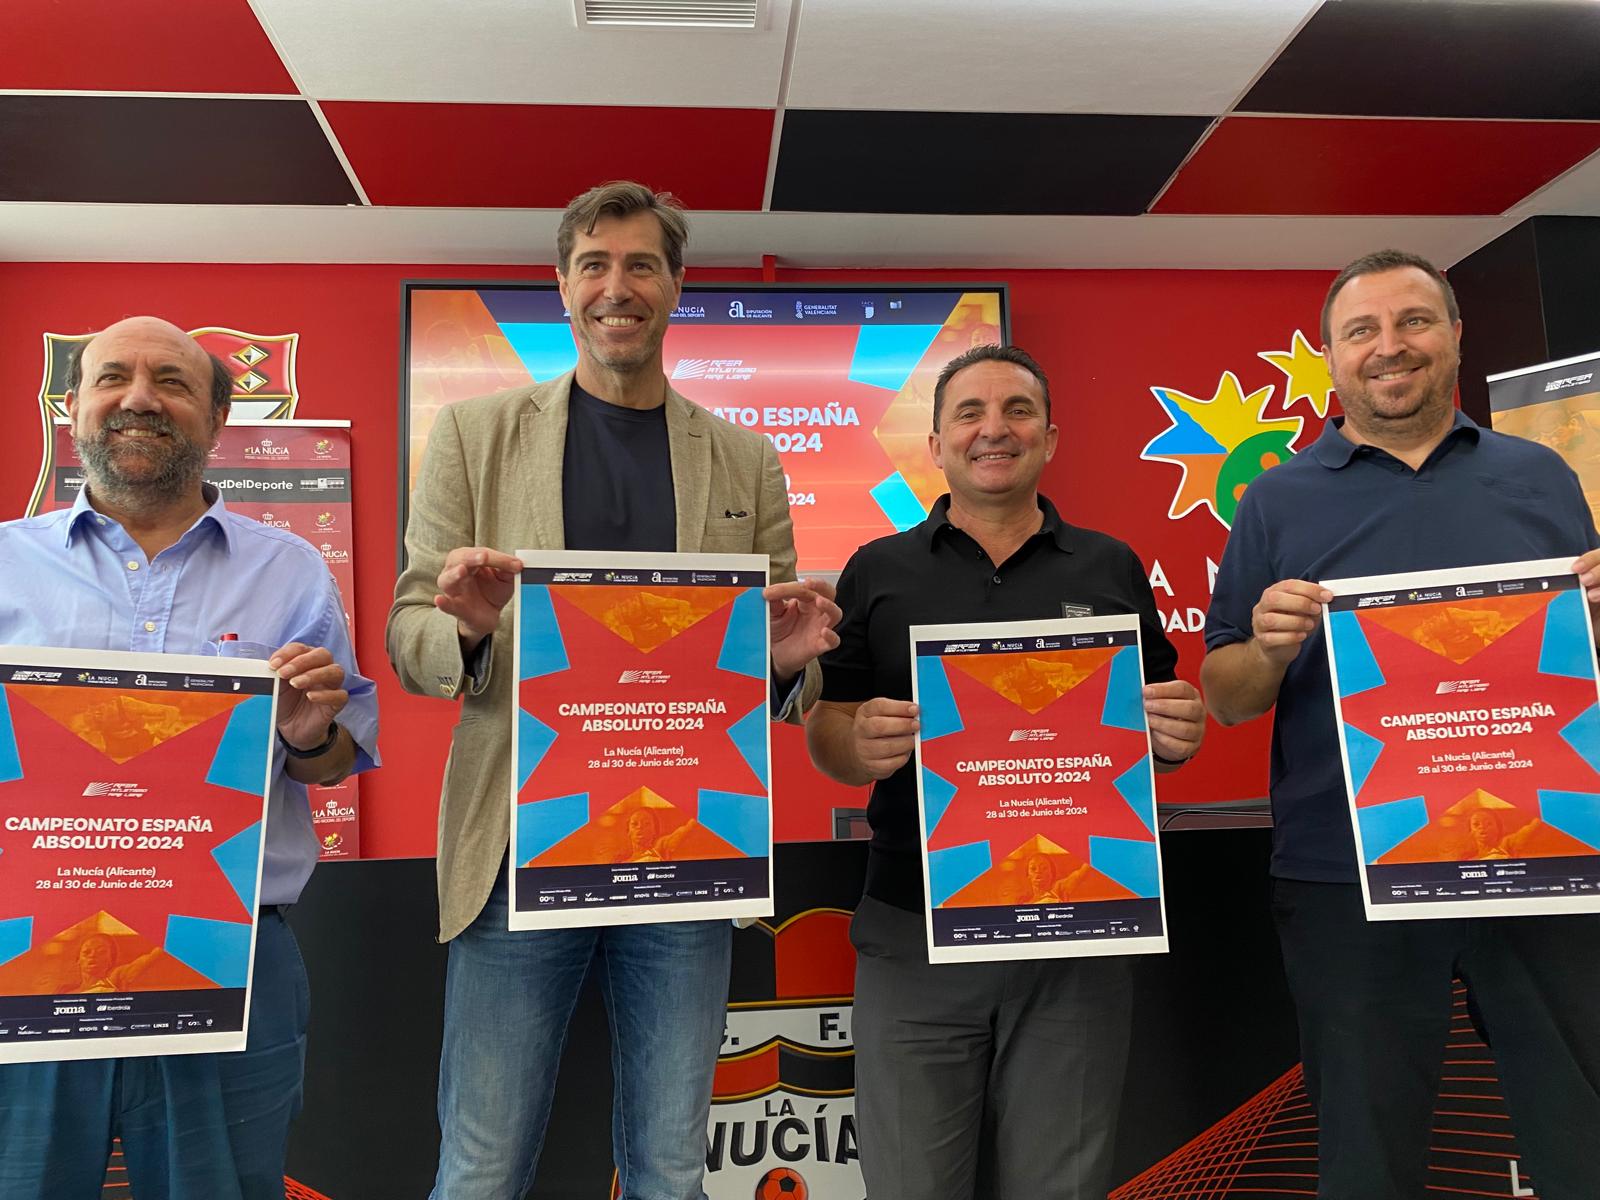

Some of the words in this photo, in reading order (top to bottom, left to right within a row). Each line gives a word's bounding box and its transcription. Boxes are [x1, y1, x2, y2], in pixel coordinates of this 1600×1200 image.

[764, 402, 860, 426] ESPAÑA
[558, 702, 666, 716] CAMPEONATO
[668, 699, 726, 714] ESPAÑA
[1380, 710, 1489, 727] CAMPEONATO
[1491, 702, 1556, 720] ESPAÑA
[582, 718, 664, 732] ABSOLUTO
[666, 718, 704, 730] 2024
[1406, 725, 1489, 741] ABSOLUTO
[1491, 722, 1533, 735] 2024
[604, 748, 614, 756] La
[617, 747, 642, 756] Nucía
[644, 746, 684, 757] (Alicante)
[1432, 754, 1443, 762] La
[1445, 753, 1470, 762] Nucía
[1472, 749, 1516, 762] (Alicante)
[588, 760, 600, 769] 28
[602, 760, 610, 768] al
[612, 760, 624, 768] 30
[626, 759, 636, 768] de
[638, 759, 662, 767] Junio
[664, 758, 674, 767] de
[675, 758, 698, 766] 2024
[956, 758, 1054, 772] CAMPEONATO
[1056, 753, 1112, 768] ESPAÑA
[1469, 762, 1493, 771] Junio
[1495, 761, 1507, 770] de
[1508, 760, 1533, 768] 2024
[978, 773, 1052, 786] ABSOLUTO
[1054, 771, 1091, 783] 2024
[999, 799, 1009, 807] La
[1010, 798, 1034, 807] Nucía
[1035, 797, 1073, 807] (Alicante)
[4, 817, 138, 832] CAMPEONATO
[142, 816, 213, 832] ESPAÑA
[32, 835, 134, 849] ABSOLUTO
[136, 836, 184, 849] 2024
[57, 867, 70, 876] La
[73, 866, 104, 876] Nucía
[106, 866, 156, 878] (Alicante)
[36, 880, 50, 889] 28
[53, 880, 63, 889] al
[65, 880, 80, 889] 30
[82, 880, 96, 889] de
[98, 880, 127, 889] Junio
[129, 880, 142, 889] de
[144, 880, 173, 888] 2024
[820, 1012, 846, 1040] F.
[765, 1098, 796, 1118] LA
